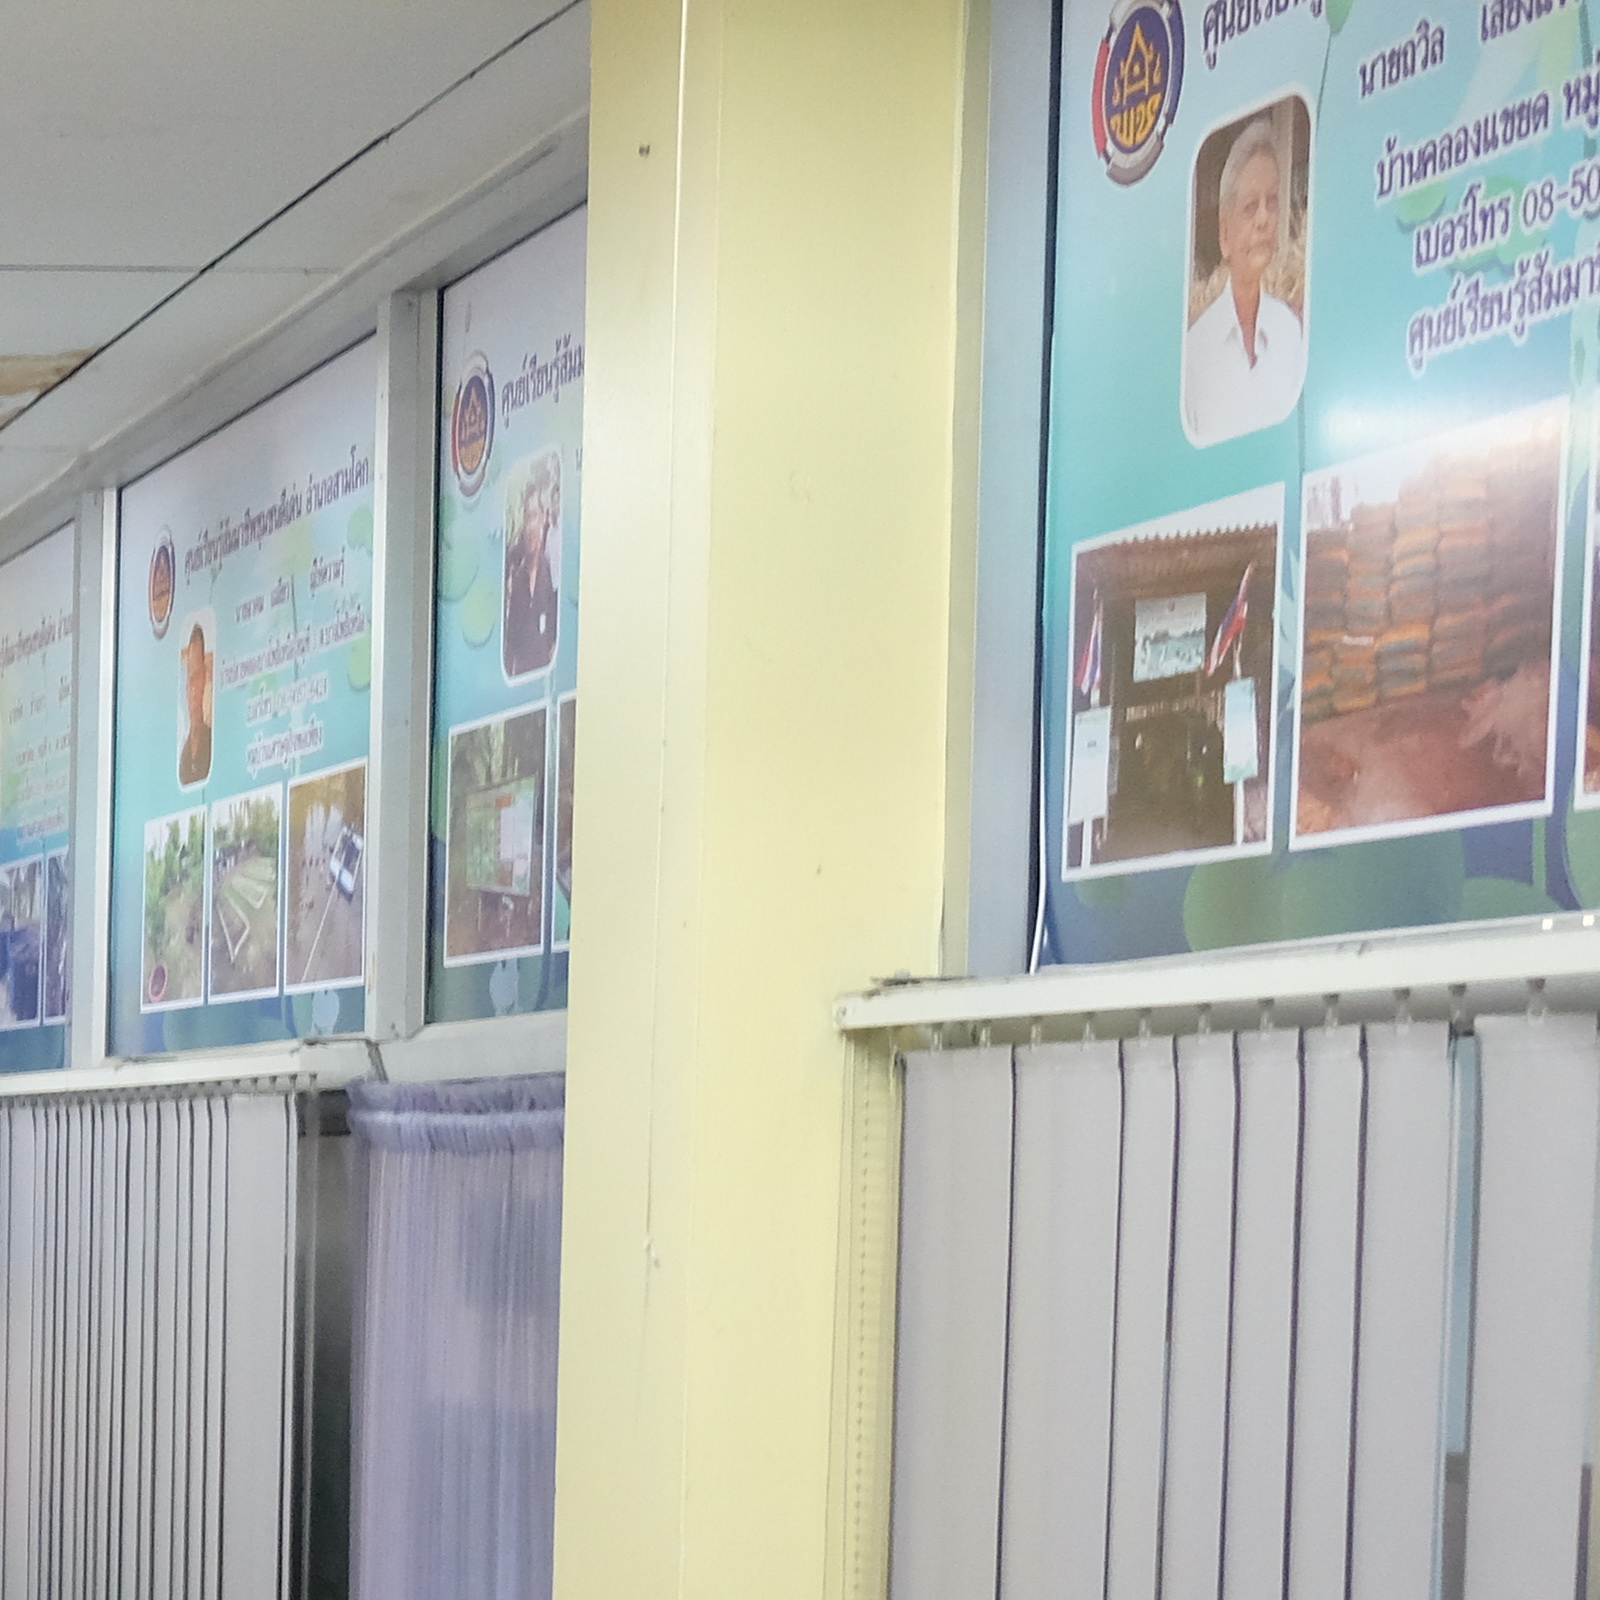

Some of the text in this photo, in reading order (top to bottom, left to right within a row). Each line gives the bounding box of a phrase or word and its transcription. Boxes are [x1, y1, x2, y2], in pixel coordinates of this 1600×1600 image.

[1359, 17, 1446, 98] นายถวิล
[1414, 184, 1511, 269] เบอร์โทร
